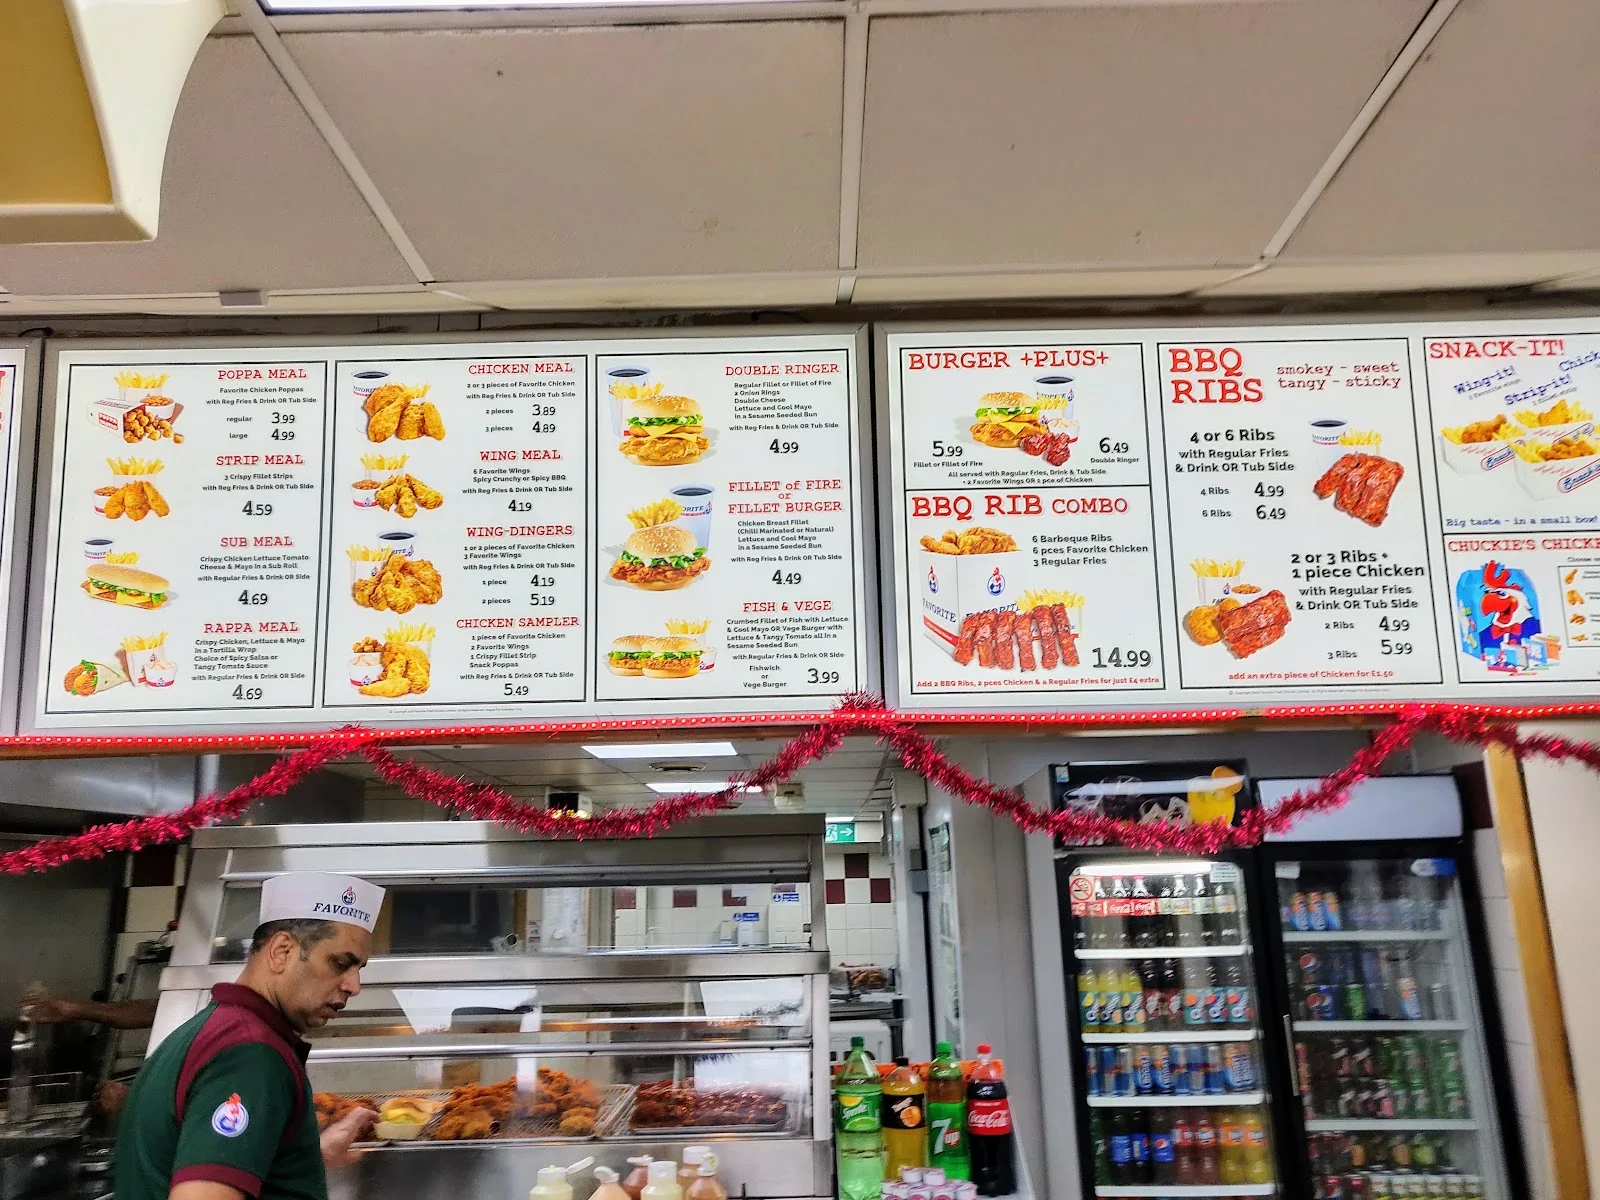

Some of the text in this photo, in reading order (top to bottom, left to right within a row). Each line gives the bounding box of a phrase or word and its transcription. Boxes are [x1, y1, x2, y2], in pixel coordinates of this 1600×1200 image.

[1429, 339, 1564, 359] SNACK-IT!
[908, 349, 1109, 370] BURGER +PLUS+
[1168, 347, 1243, 377] BBQ
[217, 368, 307, 380] POPPA MEAL
[468, 362, 573, 375] CHICKEN MEAL
[725, 363, 839, 376] DOUBLE RINGER
[1276, 361, 1400, 377] smokey sweet
[1277, 374, 1401, 391] tangy sticky
[1454, 365, 1516, 395] Wing-it!
[278, 386, 304, 394] Poppas
[1170, 378, 1263, 404] RIBS
[1504, 373, 1573, 406] Strip-it!
[490, 407, 514, 415] pieces
[531, 403, 556, 416] 3.89
[226, 411, 295, 424] regular 3.99
[490, 425, 513, 433] pieces
[531, 420, 556, 433] 4.89
[229, 428, 295, 441] large 4.99
[1190, 428, 1275, 444] 4 or 6 Ribs
[769, 438, 799, 454] 4.99
[931, 440, 963, 457] 5.99
[1099, 436, 1129, 454] 6.49
[215, 454, 303, 466] STRIP MEAL
[479, 449, 561, 461] WING MEAL
[1090, 456, 1140, 464] Double Ringer
[1178, 447, 1289, 461] with Regular Fries
[1174, 461, 1295, 473] & Drink OR Tub Side
[728, 478, 841, 492] FILLET of FIRE
[1200, 481, 1284, 498] 4 Ribs 4.99
[777, 492, 792, 500] or
[241, 500, 273, 516] 4.59
[727, 500, 842, 514] FILLET BURGER
[911, 494, 1128, 521] BBQ RIB COMBO
[1201, 504, 1286, 520] 6 Ribs 6.49
[466, 524, 573, 537] WING-DINGERS
[220, 535, 293, 548] SUB MEAL
[1031, 533, 1112, 544] 6 Barbeque Ribs
[1447, 538, 1536, 552] CHUCKIE'S
[1032, 544, 1148, 556] 6 pces Favorite Chicken
[1290, 549, 1377, 565] 2 or 3 Ribs
[199, 555, 223, 563] Crispy
[1033, 556, 1107, 567] 3 Regular Fries
[771, 569, 802, 585] 4.49
[1291, 563, 1425, 582] 1 piece Chicken
[487, 578, 507, 587] piece
[237, 589, 268, 605] 4.69
[1298, 584, 1412, 598] with Regular Fries
[487, 597, 511, 606] pieces
[742, 600, 832, 613] FISH & VEGE
[1295, 598, 1418, 610] & Drink OR Tub Side
[203, 621, 298, 634] RAPPA MEAL
[456, 616, 580, 629] CHICKEN SAMPLER
[1332, 620, 1355, 629] Ribs
[1378, 615, 1410, 632] 4.99
[1327, 638, 1413, 660] 3 Ribs 5.99
[1091, 646, 1151, 669] 14.99
[807, 667, 840, 684] 3.99
[1228, 672, 1246, 680] add
[1284, 671, 1308, 681] piece
[1309, 670, 1319, 678] of
[1320, 670, 1355, 678] Chicken
[1356, 669, 1370, 677] for
[231, 683, 263, 700] 4.69
[503, 682, 529, 696] 5.49
[742, 681, 787, 689] Vege Burger
